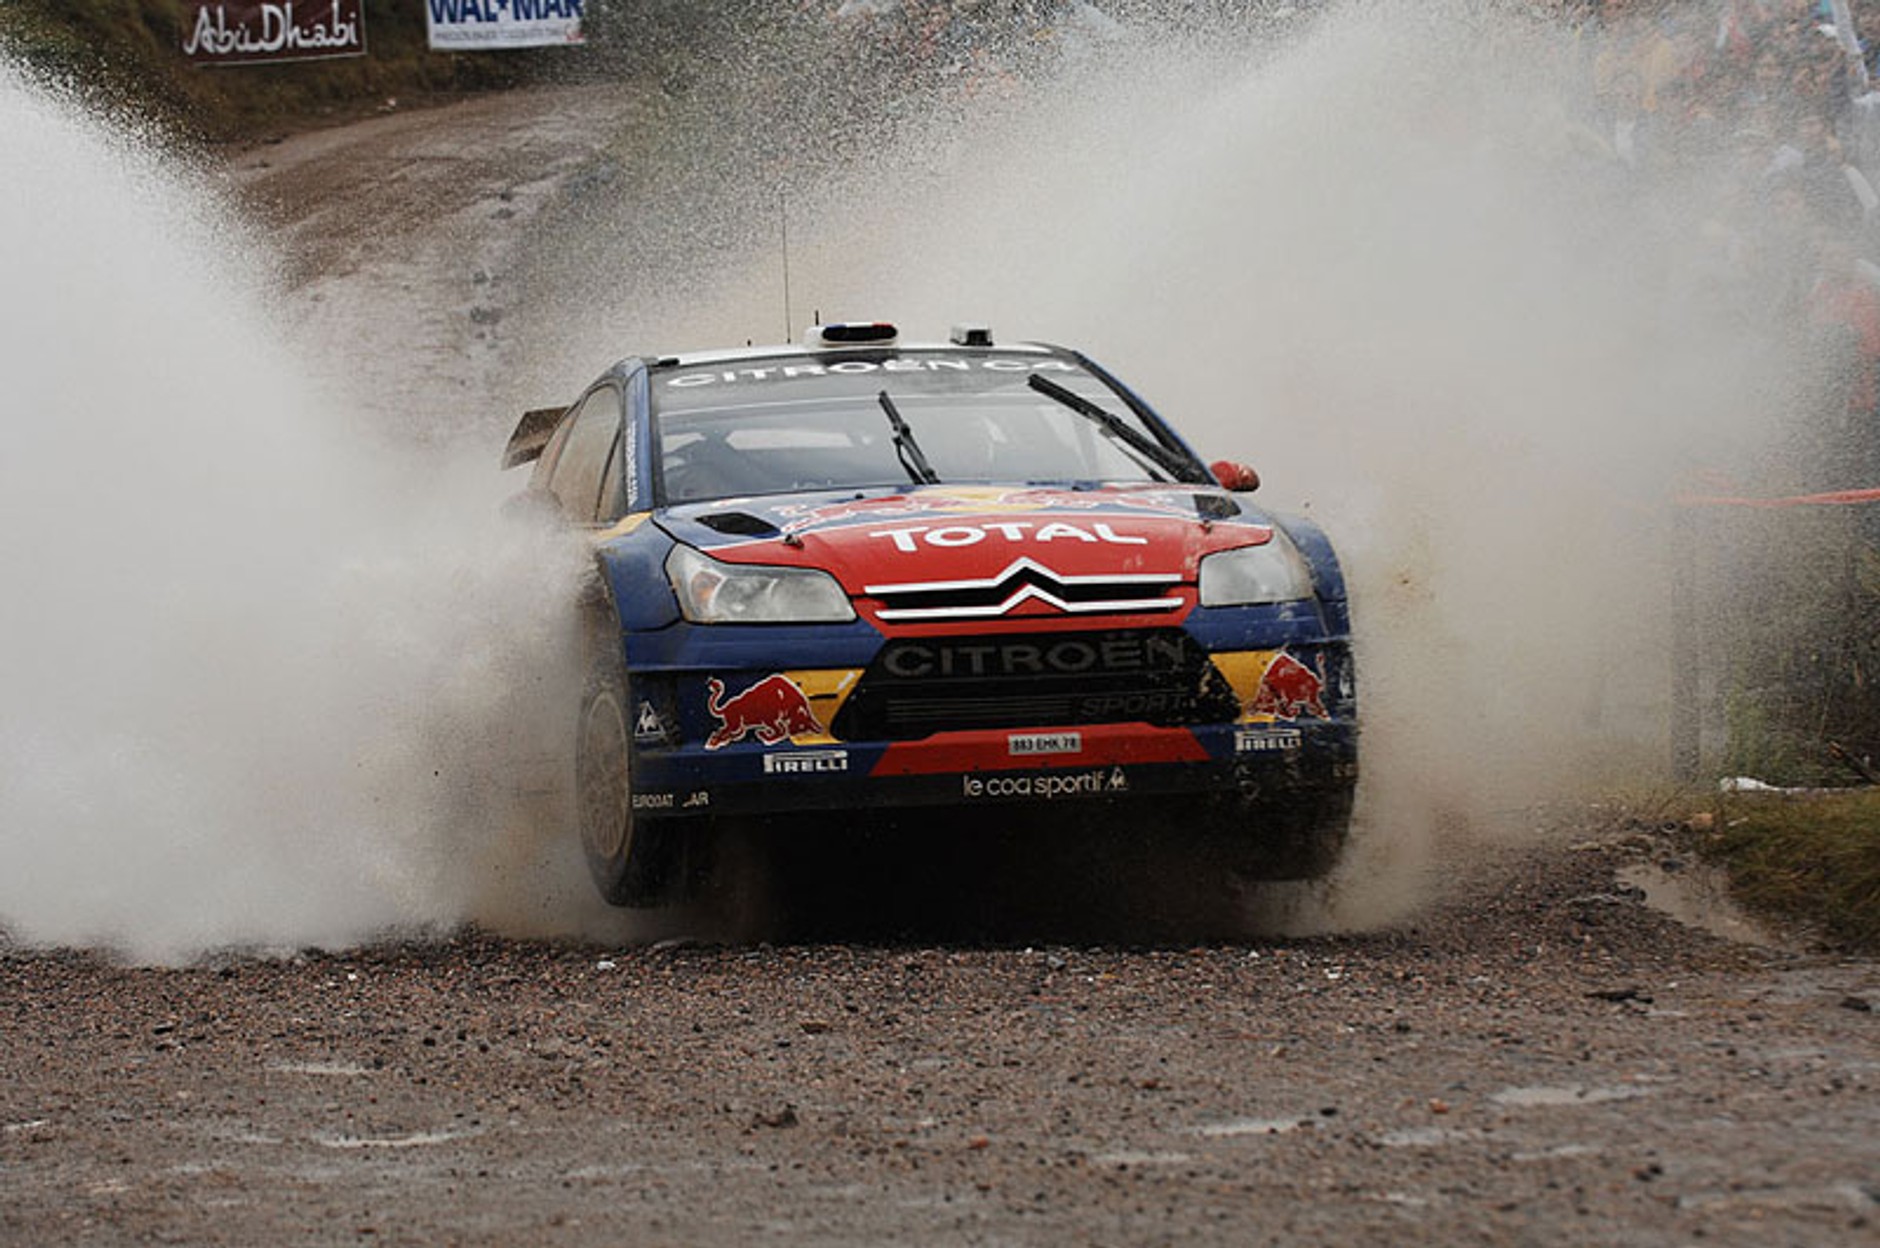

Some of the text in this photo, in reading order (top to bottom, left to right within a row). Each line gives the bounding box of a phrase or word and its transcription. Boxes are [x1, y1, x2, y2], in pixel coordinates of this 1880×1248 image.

[870, 522, 1148, 552] TOTAL
[884, 632, 1187, 676] CITROËN
[763, 750, 849, 773] PIRELLI
[963, 774, 983, 796] le
[1034, 769, 1104, 799] sportif
